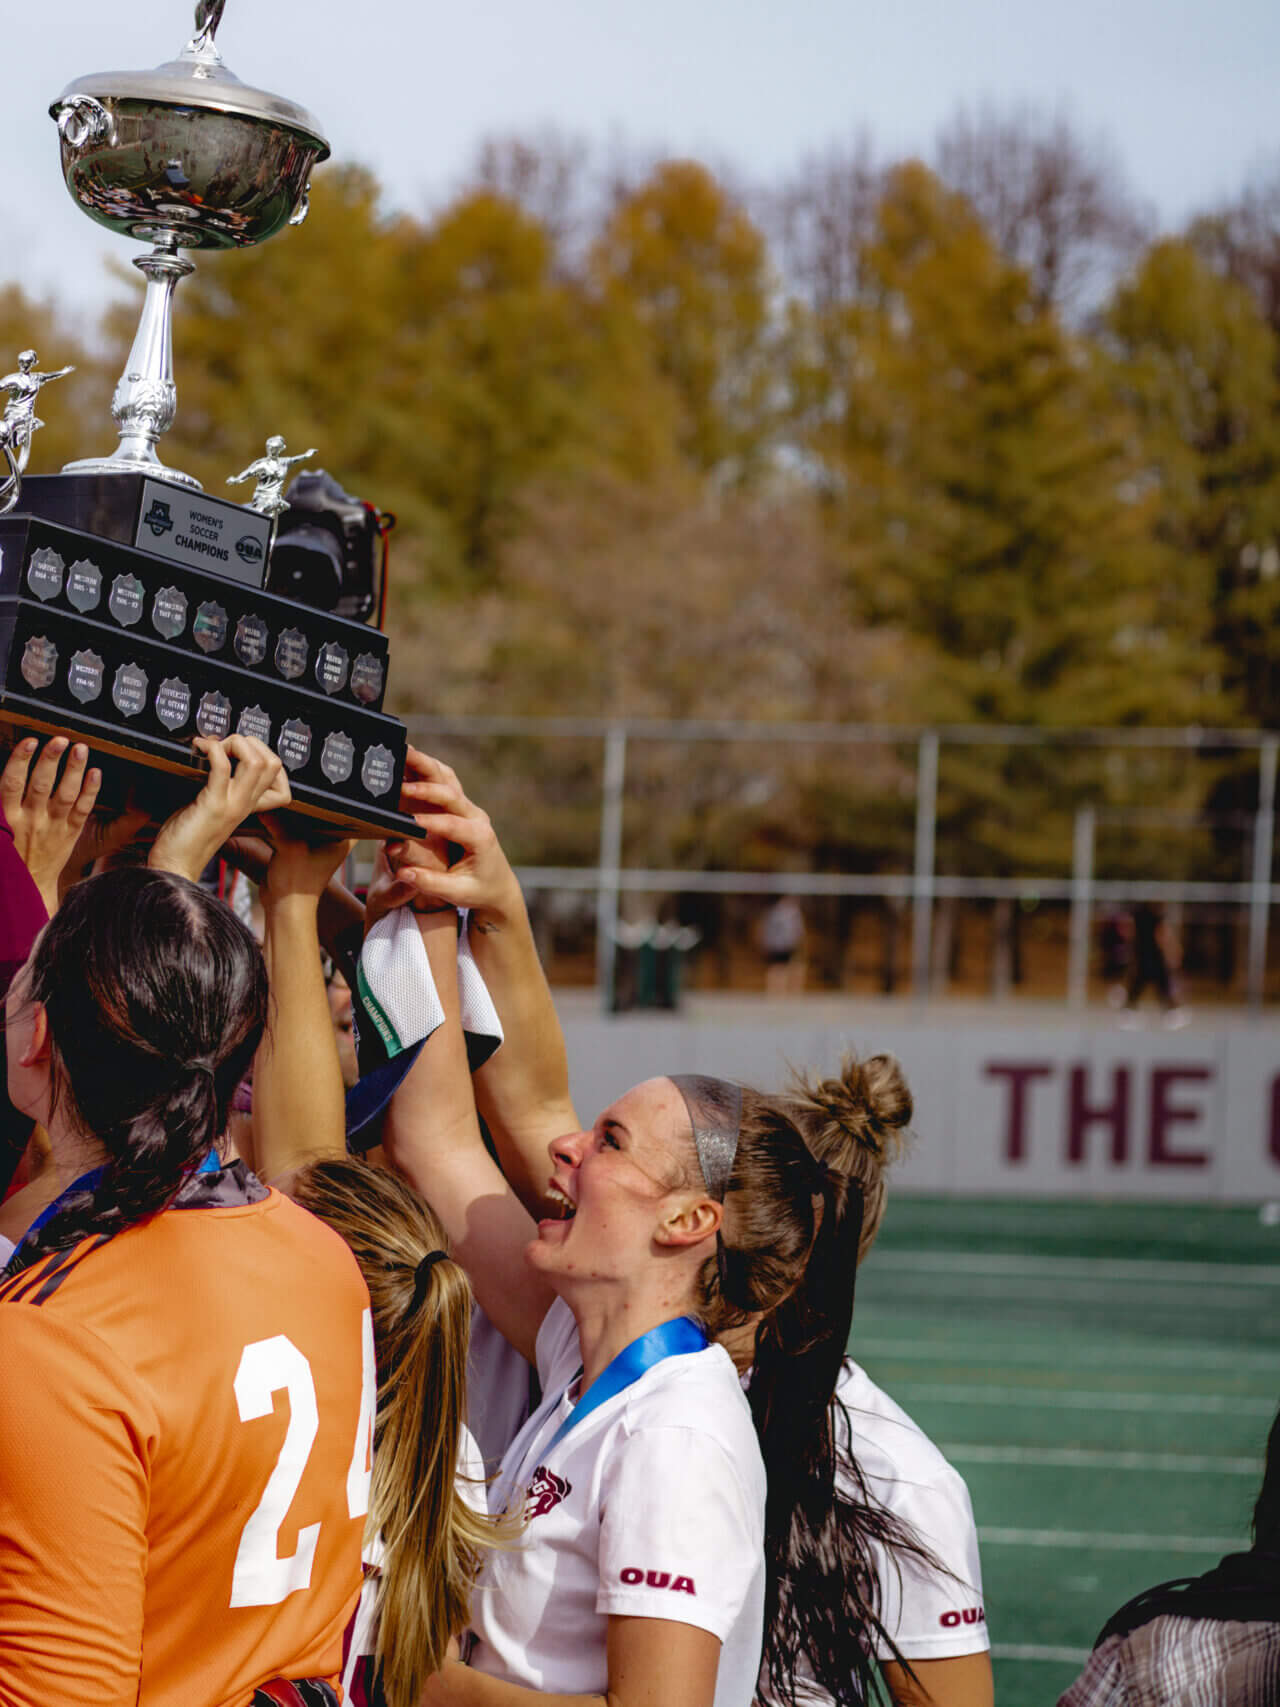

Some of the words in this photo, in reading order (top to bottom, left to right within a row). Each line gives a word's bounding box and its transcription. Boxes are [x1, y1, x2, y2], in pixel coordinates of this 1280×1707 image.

[189, 510, 224, 529] WOMEN'S
[190, 524, 219, 541] SOCCER
[175, 534, 229, 561] CHAMPIONS
[235, 542, 263, 561] OUA
[362, 995, 393, 1042] CHAMPIONS
[984, 1060, 1213, 1168] THE
[620, 1566, 697, 1596] OUA
